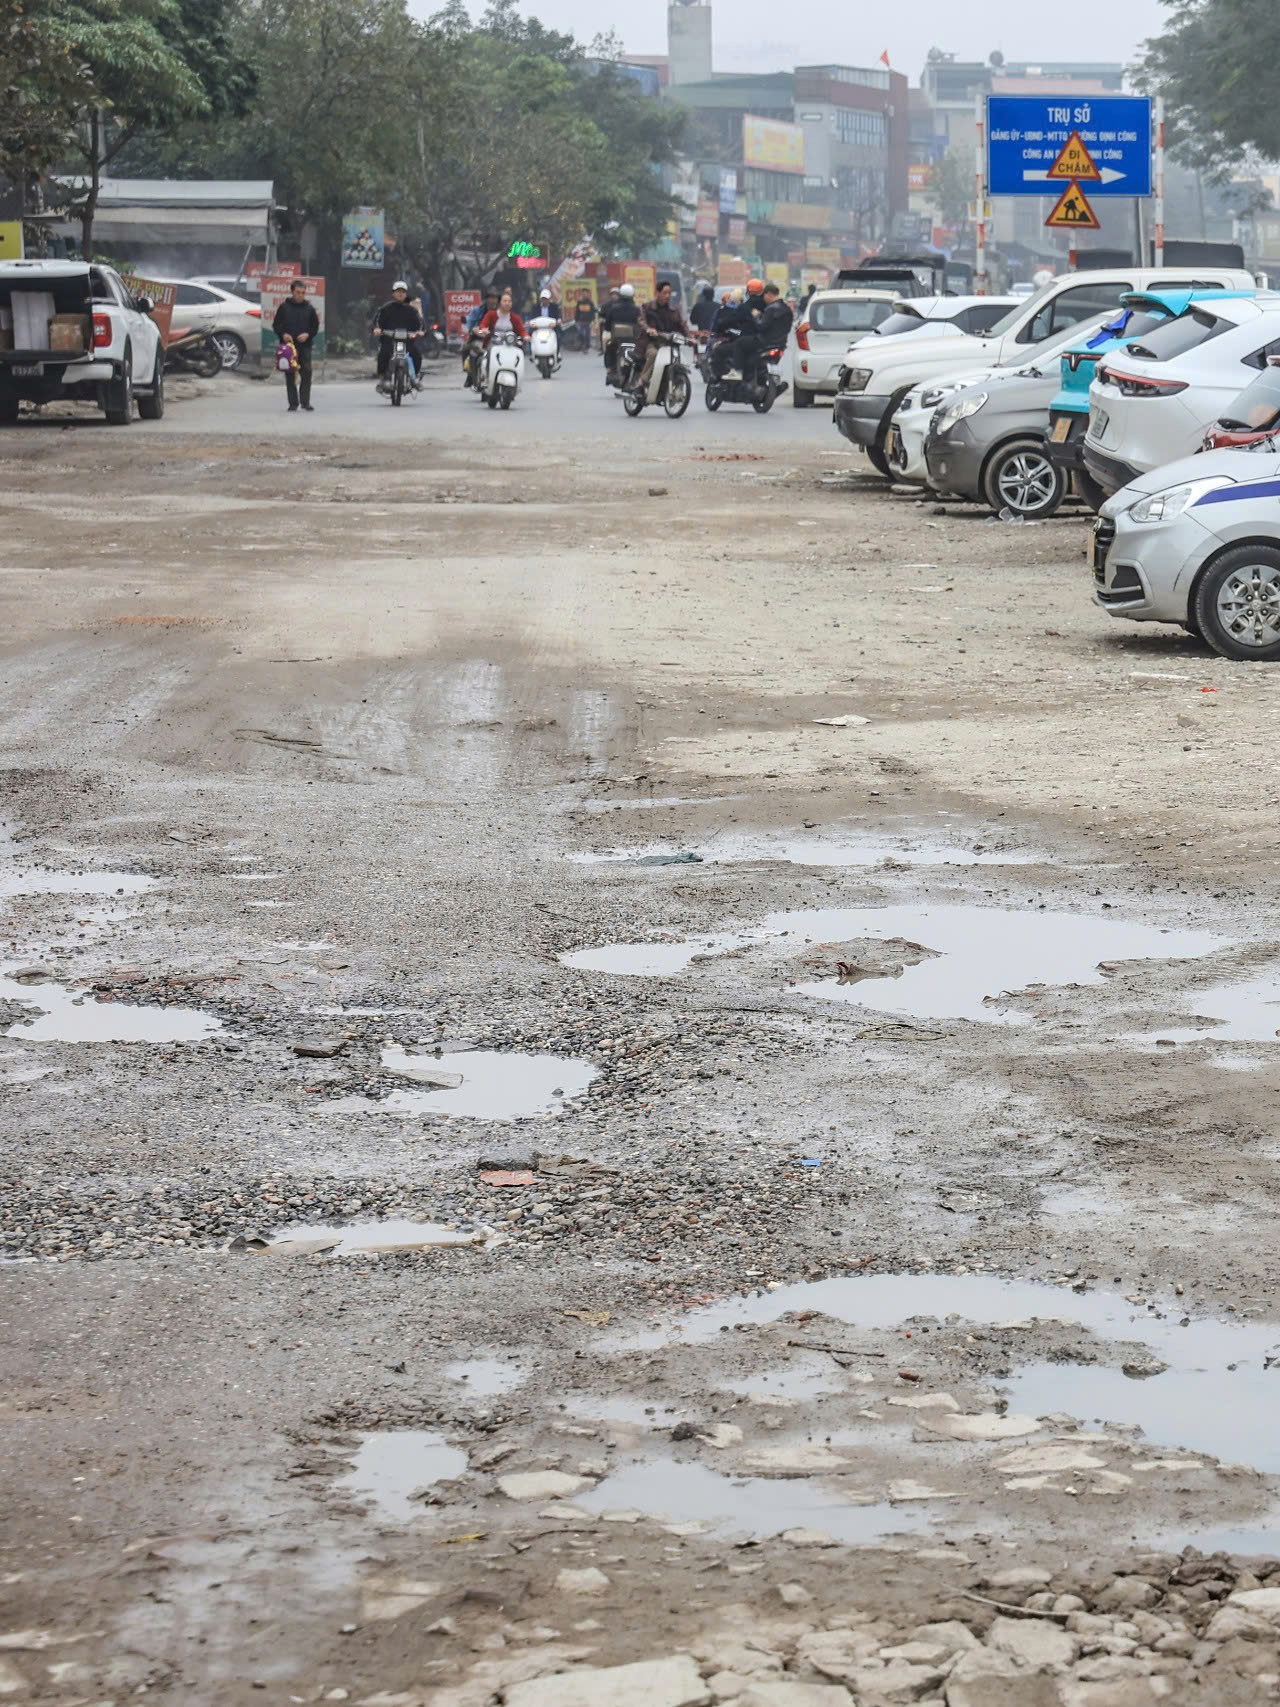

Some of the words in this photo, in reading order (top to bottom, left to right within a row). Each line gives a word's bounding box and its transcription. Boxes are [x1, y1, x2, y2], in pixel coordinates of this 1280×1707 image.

[1047, 107, 1070, 126] TRỤ
[1073, 103, 1091, 123] SỞ
[1117, 129, 1137, 142] CÔNG
[1043, 150, 1054, 159] AN
[1069, 151, 1080, 160] ĐI
[1103, 148, 1123, 160] CÔNG
